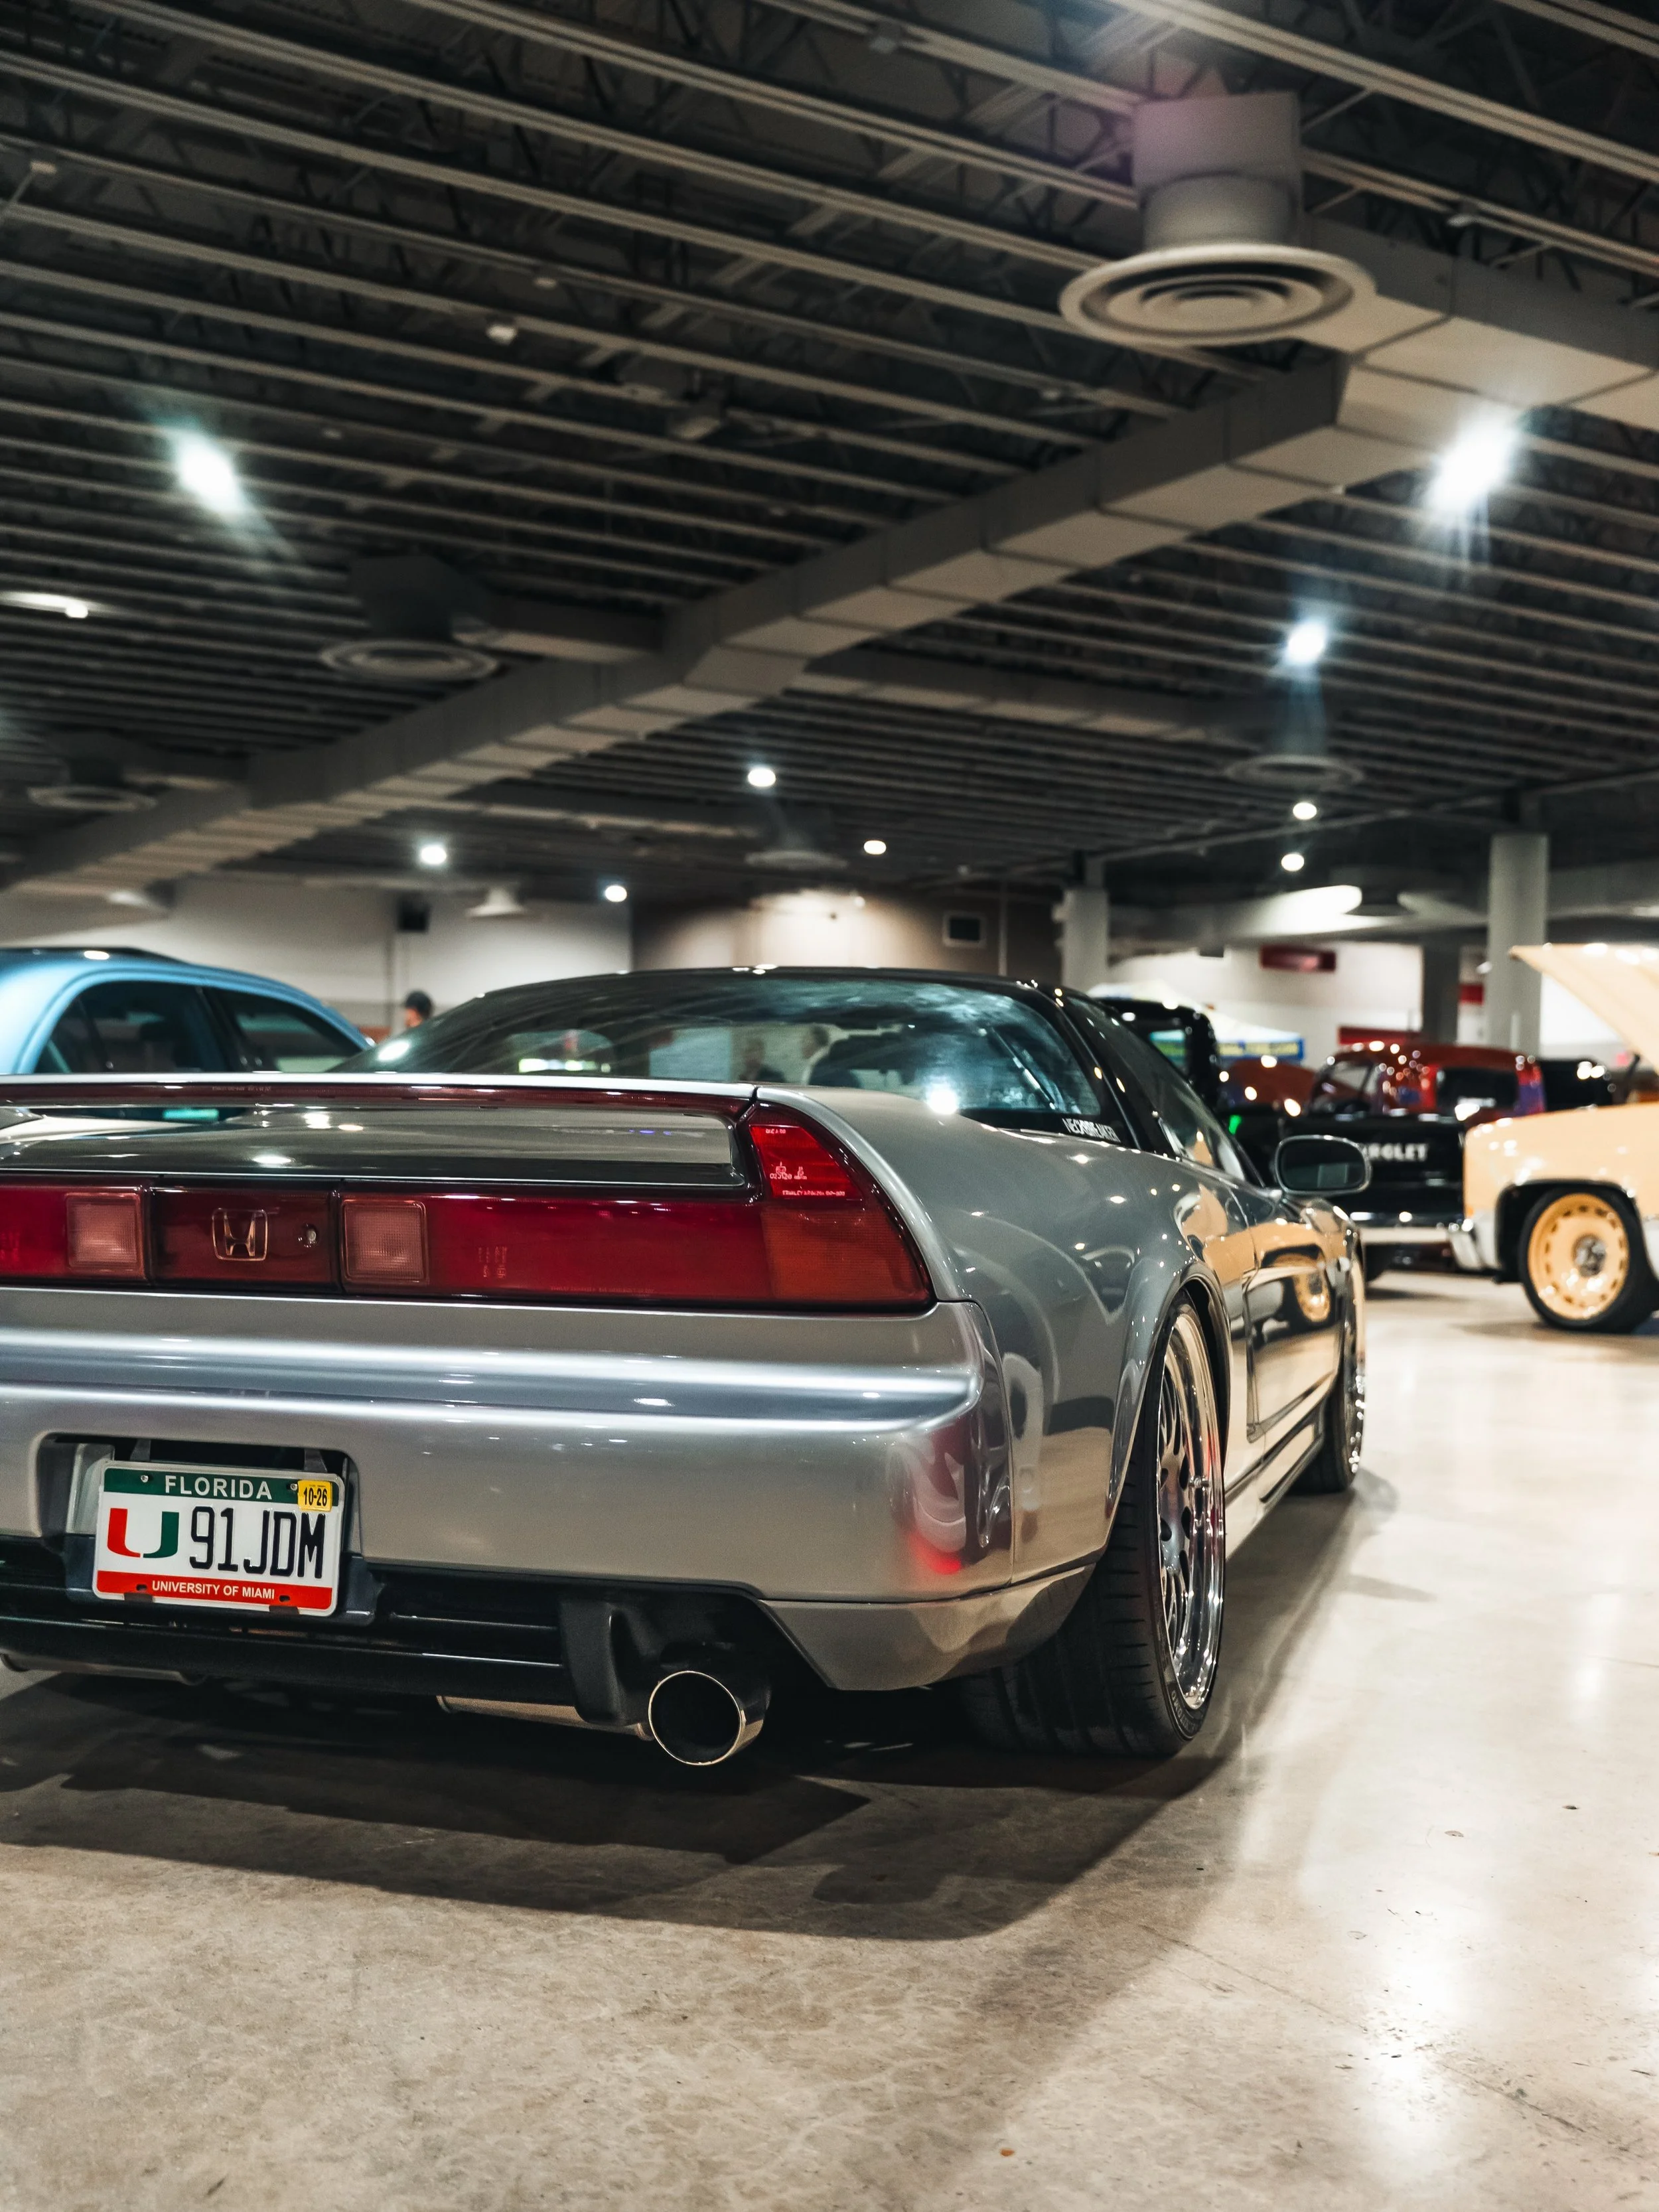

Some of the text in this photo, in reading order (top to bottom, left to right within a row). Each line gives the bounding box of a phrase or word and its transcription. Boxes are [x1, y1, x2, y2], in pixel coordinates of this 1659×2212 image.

[165, 1475, 272, 1500] FLORIDA
[303, 1487, 328, 1507] 10-26
[189, 1505, 326, 1579] 91JDM
[152, 1580, 275, 1599] UNIVERSITY OF MIAMI
